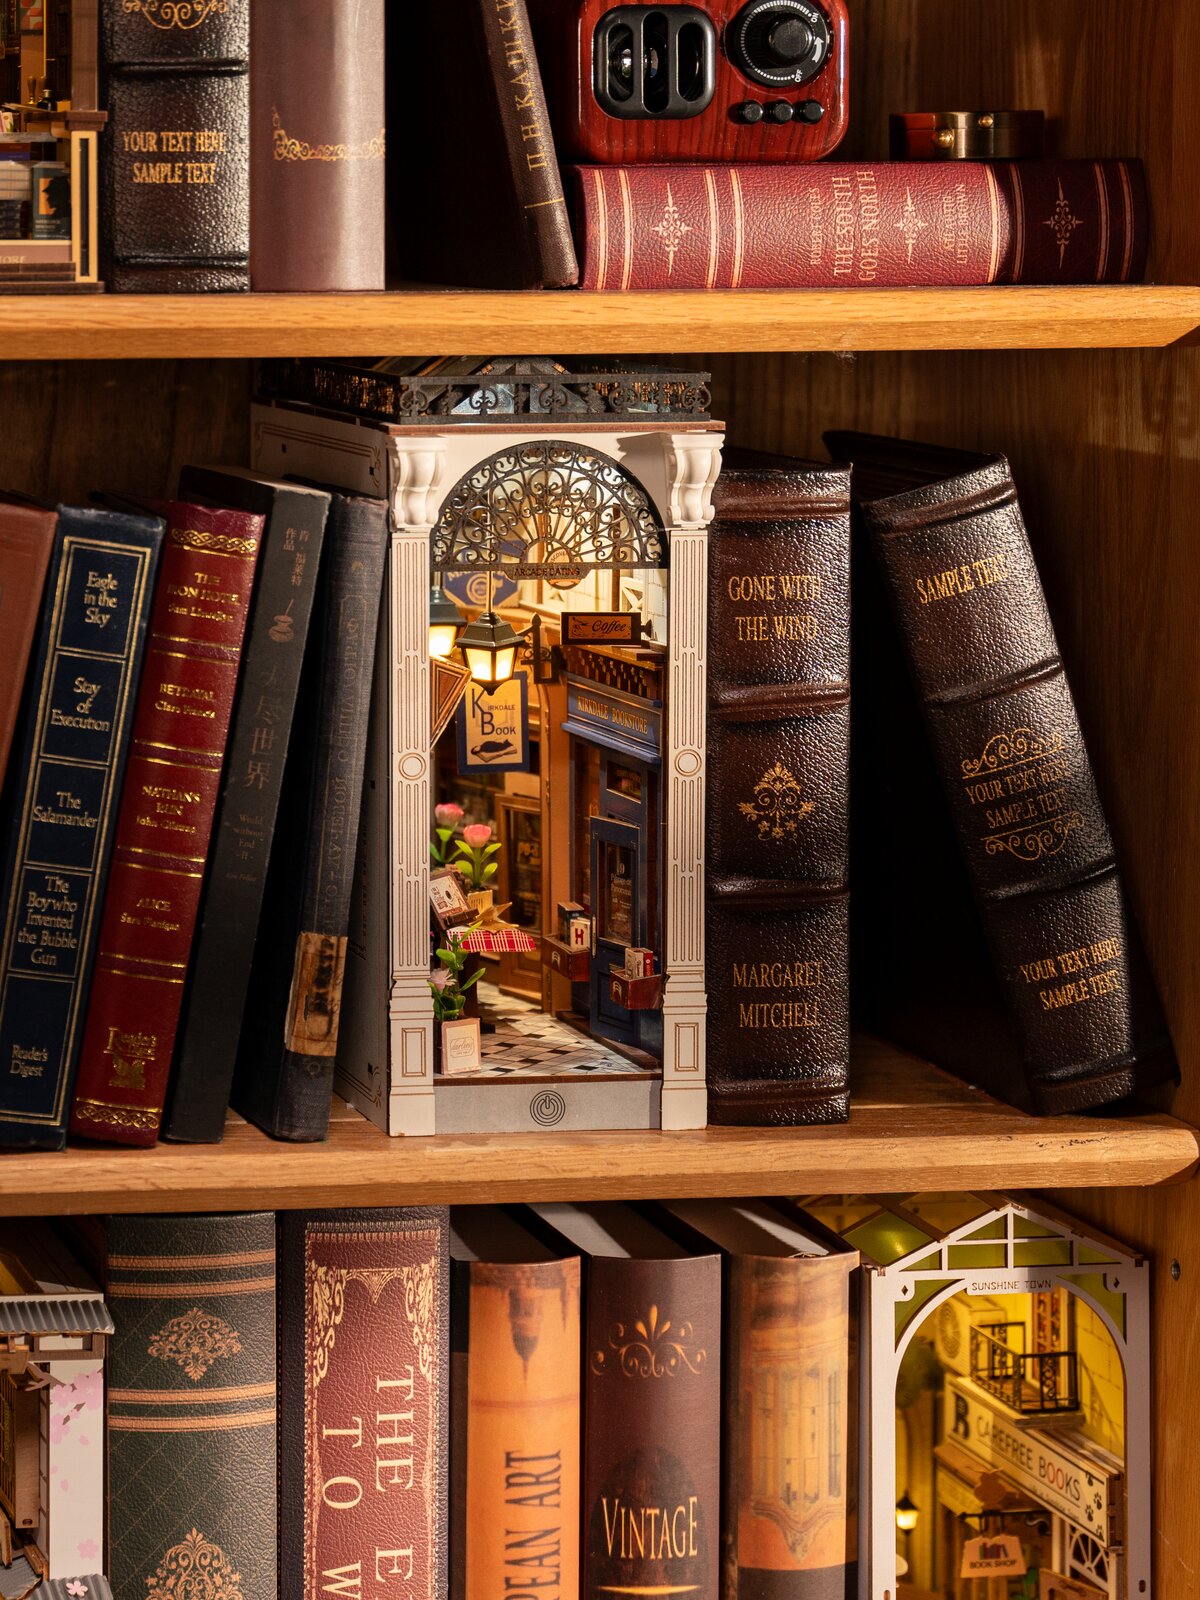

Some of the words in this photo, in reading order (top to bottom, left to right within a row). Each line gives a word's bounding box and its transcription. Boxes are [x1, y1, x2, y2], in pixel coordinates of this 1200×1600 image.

[811, 12, 819, 22] ON
[795, 69, 803, 82] OFF
[121, 131, 157, 152] YOUR
[160, 131, 193, 152] TEXT
[195, 131, 226, 153] HERE
[132, 162, 182, 184] SAMPLE
[186, 162, 216, 184] TEXT
[809, 187, 823, 222] COLES
[832, 175, 855, 236] SOUTH
[856, 170, 879, 232] NORTH
[955, 183, 970, 226] BROWN
[810, 223, 823, 265] ROBERT
[833, 238, 854, 277] THE
[858, 236, 879, 281] GOES
[86, 571, 118, 591] Eagle
[194, 572, 222, 586] THE
[728, 576, 776, 601] GONE
[780, 575, 821, 601] WITH
[916, 565, 975, 604] SAMPLE
[973, 554, 1009, 587] TEXT
[84, 590, 96, 606] in
[98, 591, 118, 609] the
[84, 607, 111, 628] Sky
[592, 620, 626, 633] Coffee
[735, 616, 769, 640] THE
[773, 615, 818, 640] WIND
[73, 676, 102, 698] Stay
[160, 683, 216, 700] BETRAYAL
[76, 698, 94, 714] of
[578, 696, 609, 719] KIRKDALE
[612, 707, 648, 735] BOOKSTORE
[51, 709, 111, 732] Execution
[964, 778, 1006, 805] YOUR
[1005, 768, 1038, 795] TEXT
[56, 791, 82, 810] The
[985, 798, 1038, 829] SAMPLE
[1037, 787, 1067, 813] TEXT
[32, 806, 98, 828] Salamander
[45, 875, 70, 893] The
[27, 891, 52, 912] Boy
[53, 896, 78, 913] who
[136, 899, 172, 912] ALICE
[26, 909, 75, 930] Invented
[18, 927, 37, 945] the
[40, 930, 78, 949] Bubble
[31, 948, 57, 966] Gun
[1020, 958, 1059, 983] YOUR
[1057, 948, 1090, 975] TEXT
[1090, 937, 1121, 965] HERE
[732, 960, 822, 988] MARGARET
[1040, 979, 1090, 1010] SAMPLE
[1089, 969, 1120, 996] TEXT
[739, 1000, 818, 1028] MITCHELL
[12, 1044, 48, 1061] Reader's
[10, 1060, 44, 1078] Digest
[971, 1281, 1020, 1291] SUNSHINE
[1024, 1279, 1052, 1289] TOWN
[375, 1364, 414, 1492] THE
[322, 1416, 363, 1510] TO
[976, 1416, 1034, 1471] CAREFREE
[1038, 1455, 1081, 1501] BOOKS
[504, 1449, 562, 1509] ART
[602, 1496, 698, 1560] VINTAGE
[375, 1544, 414, 1600] E
[970, 1560, 992, 1569] BOOK
[994, 1559, 1018, 1568] SHOP
